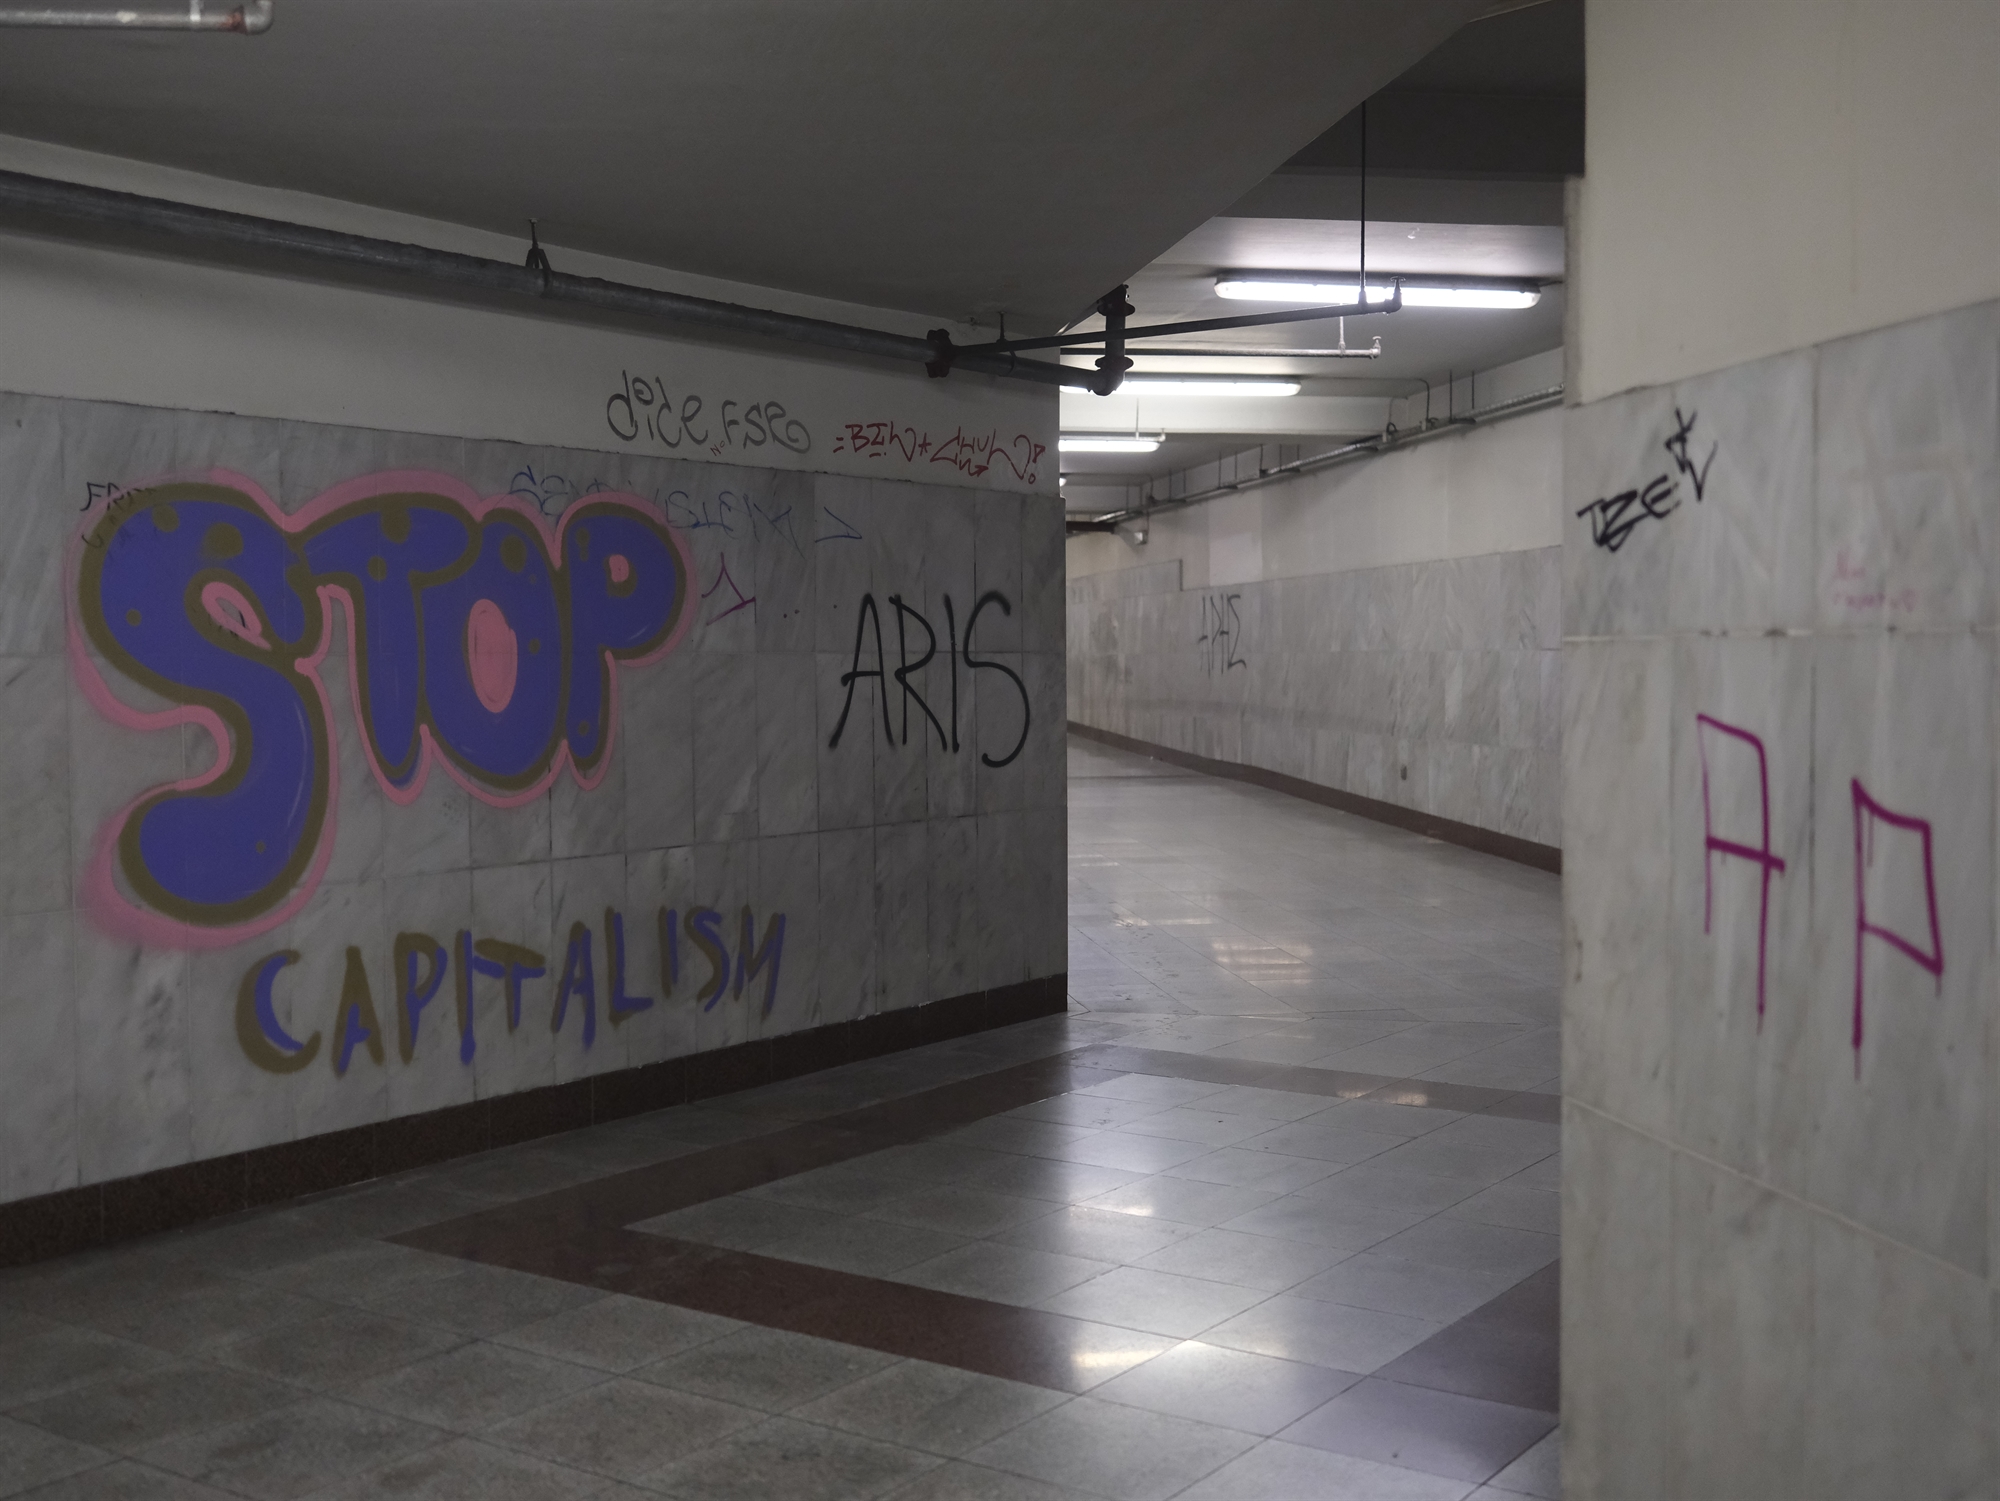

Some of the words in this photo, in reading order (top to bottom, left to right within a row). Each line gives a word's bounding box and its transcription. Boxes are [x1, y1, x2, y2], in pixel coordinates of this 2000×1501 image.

[70, 474, 692, 942] STOP
[828, 590, 1031, 768] ARIS
[235, 904, 787, 1079] CAPITALISM
